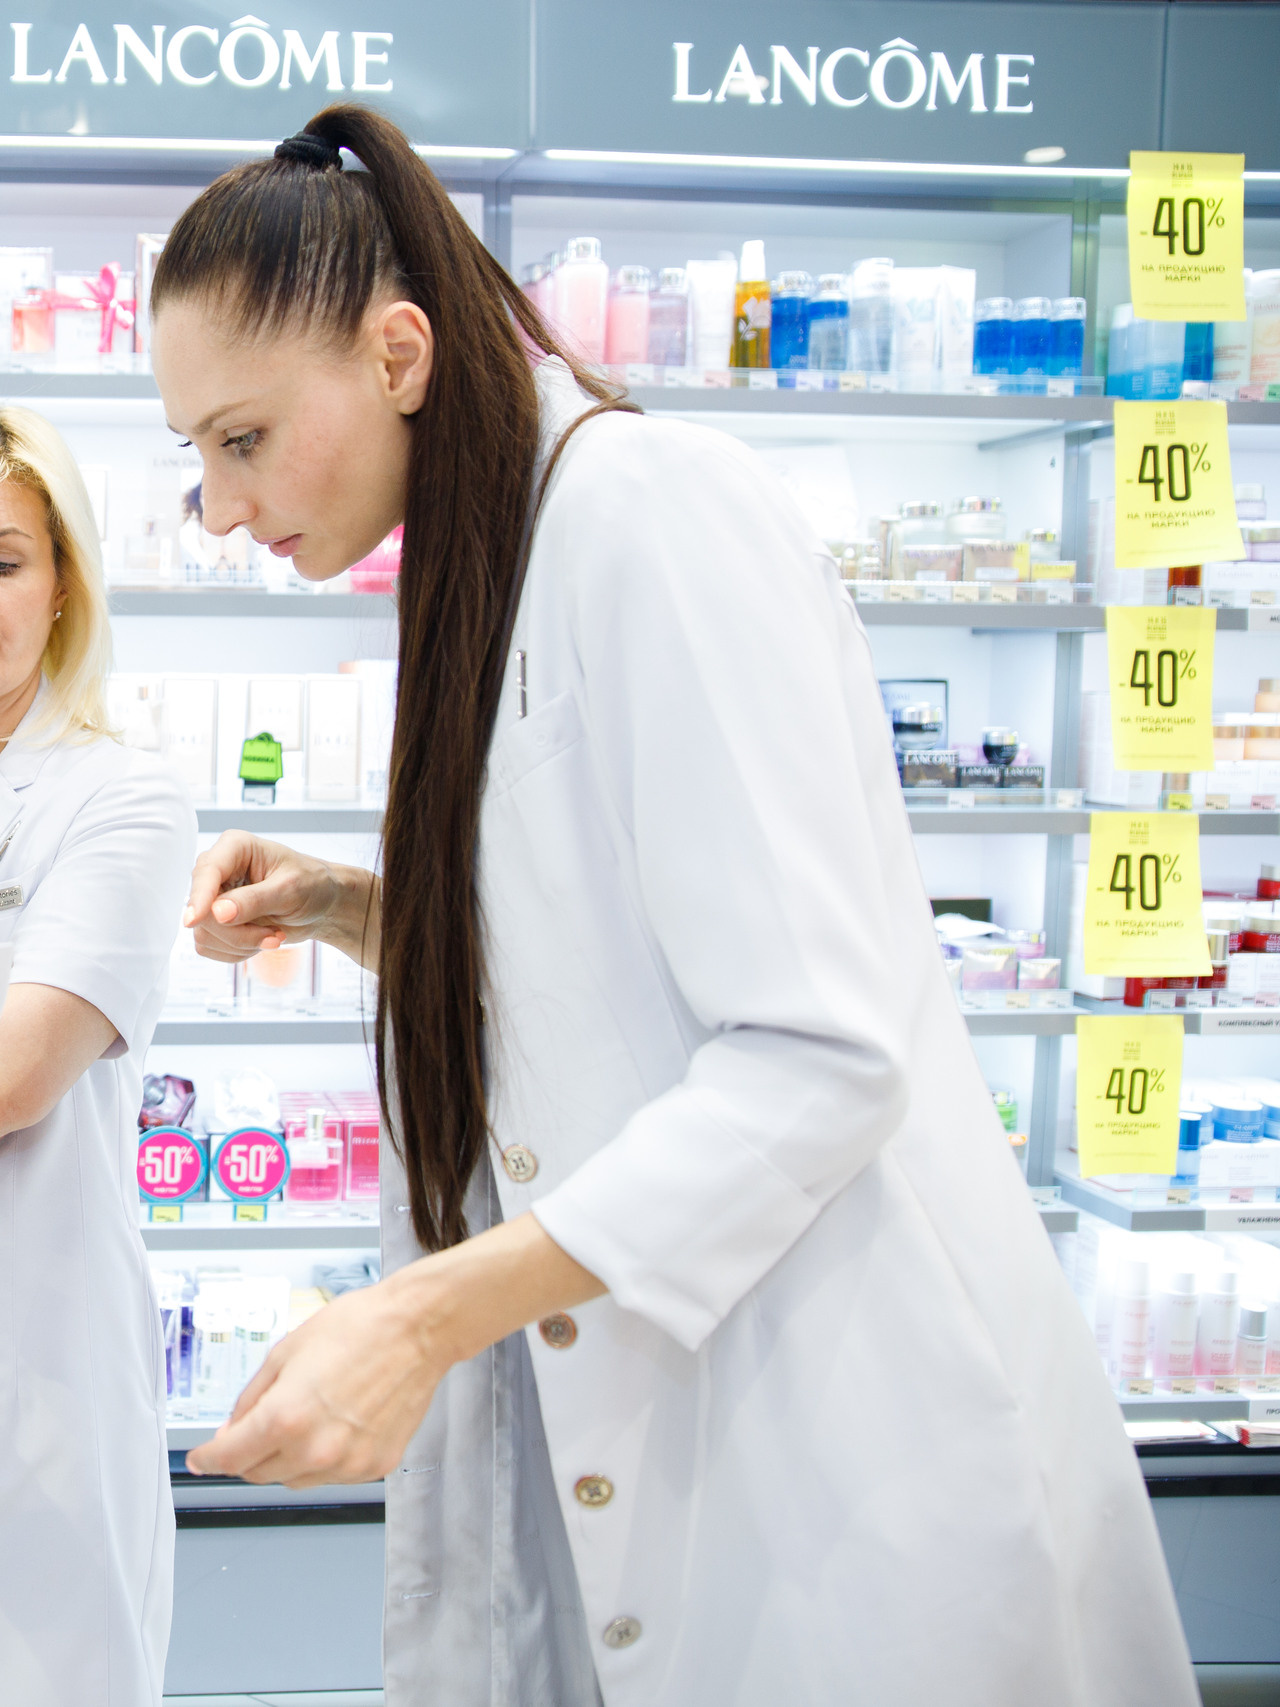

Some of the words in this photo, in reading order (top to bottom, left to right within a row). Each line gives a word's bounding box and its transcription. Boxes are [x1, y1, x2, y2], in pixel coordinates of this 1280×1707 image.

[9, 14, 395, 92] LANCÔME
[671, 37, 1036, 114] LANCÔME
[144, 1145, 195, 1184] 50%
[229, 1144, 279, 1184] 50%
